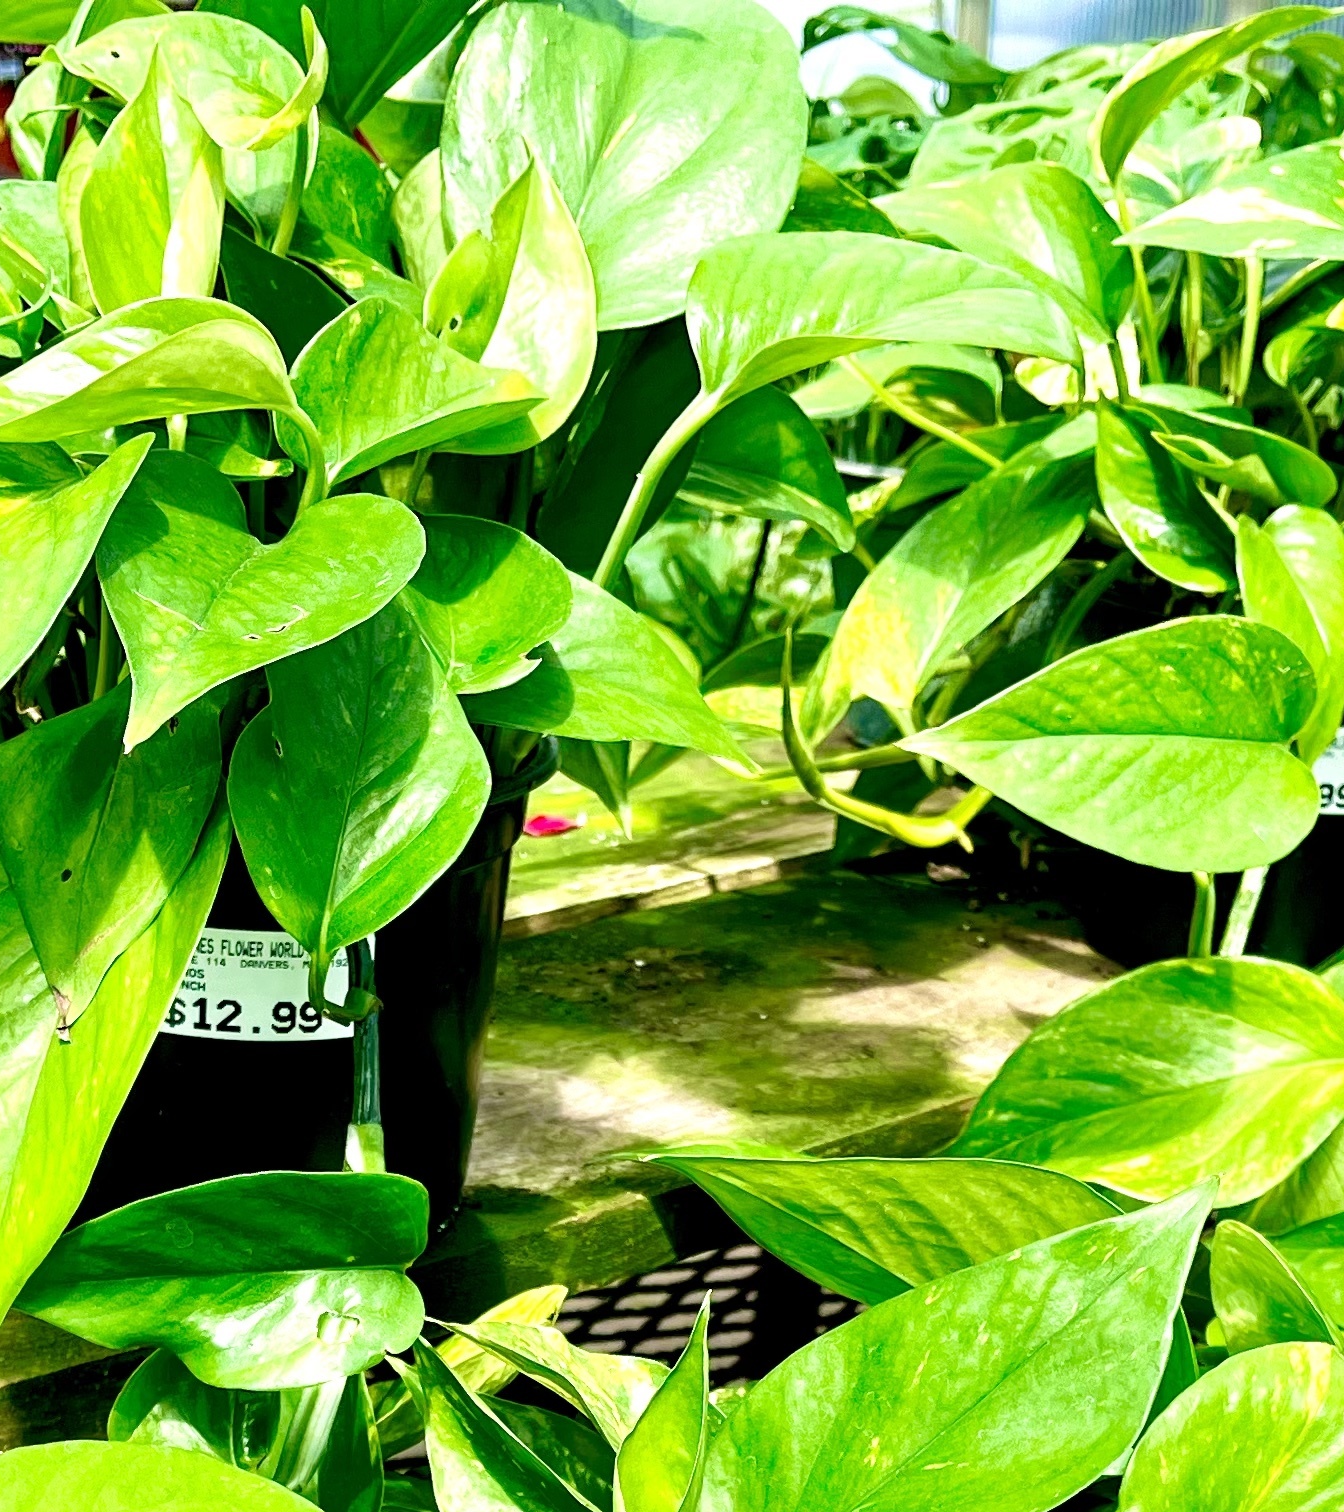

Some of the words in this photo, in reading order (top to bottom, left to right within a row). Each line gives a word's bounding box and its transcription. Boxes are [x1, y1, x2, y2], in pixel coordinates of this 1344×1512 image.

[221, 939, 264, 957] FLOWER
[207, 957, 226, 967] 114
[164, 996, 323, 1034] $12.99
